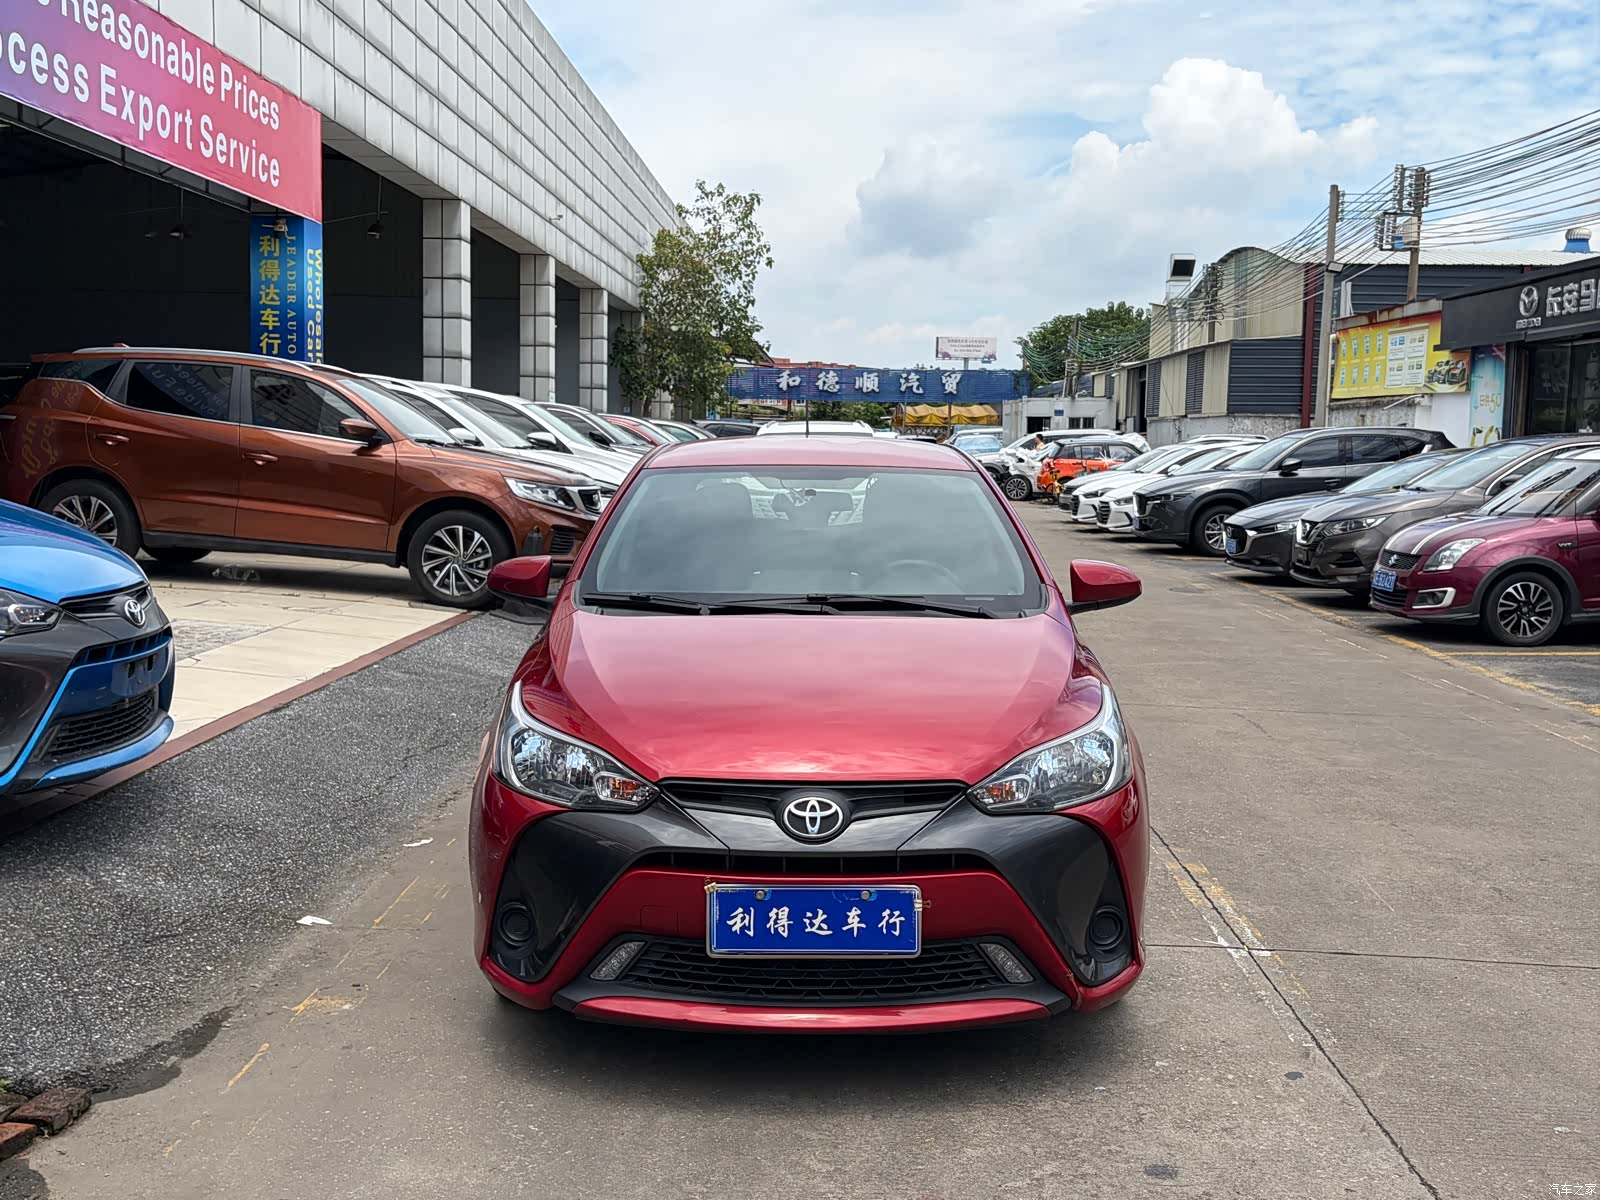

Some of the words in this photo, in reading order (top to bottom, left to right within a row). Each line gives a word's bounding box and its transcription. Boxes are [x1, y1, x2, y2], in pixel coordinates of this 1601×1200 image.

[0, 32, 89, 102] cess
[100, 63, 193, 150] Export
[200, 114, 280, 187] Service
[221, 61, 280, 130] Prices
[258, 235, 282, 355] 利得达车行
[287, 235, 297, 303] LEADER
[307, 248, 315, 309] Used
[1546, 278, 1600, 317] 长安马
[287, 309, 297, 355] AUTO
[776, 369, 963, 395] 和德顺汽贸
[726, 906, 906, 938] 利得达车行
